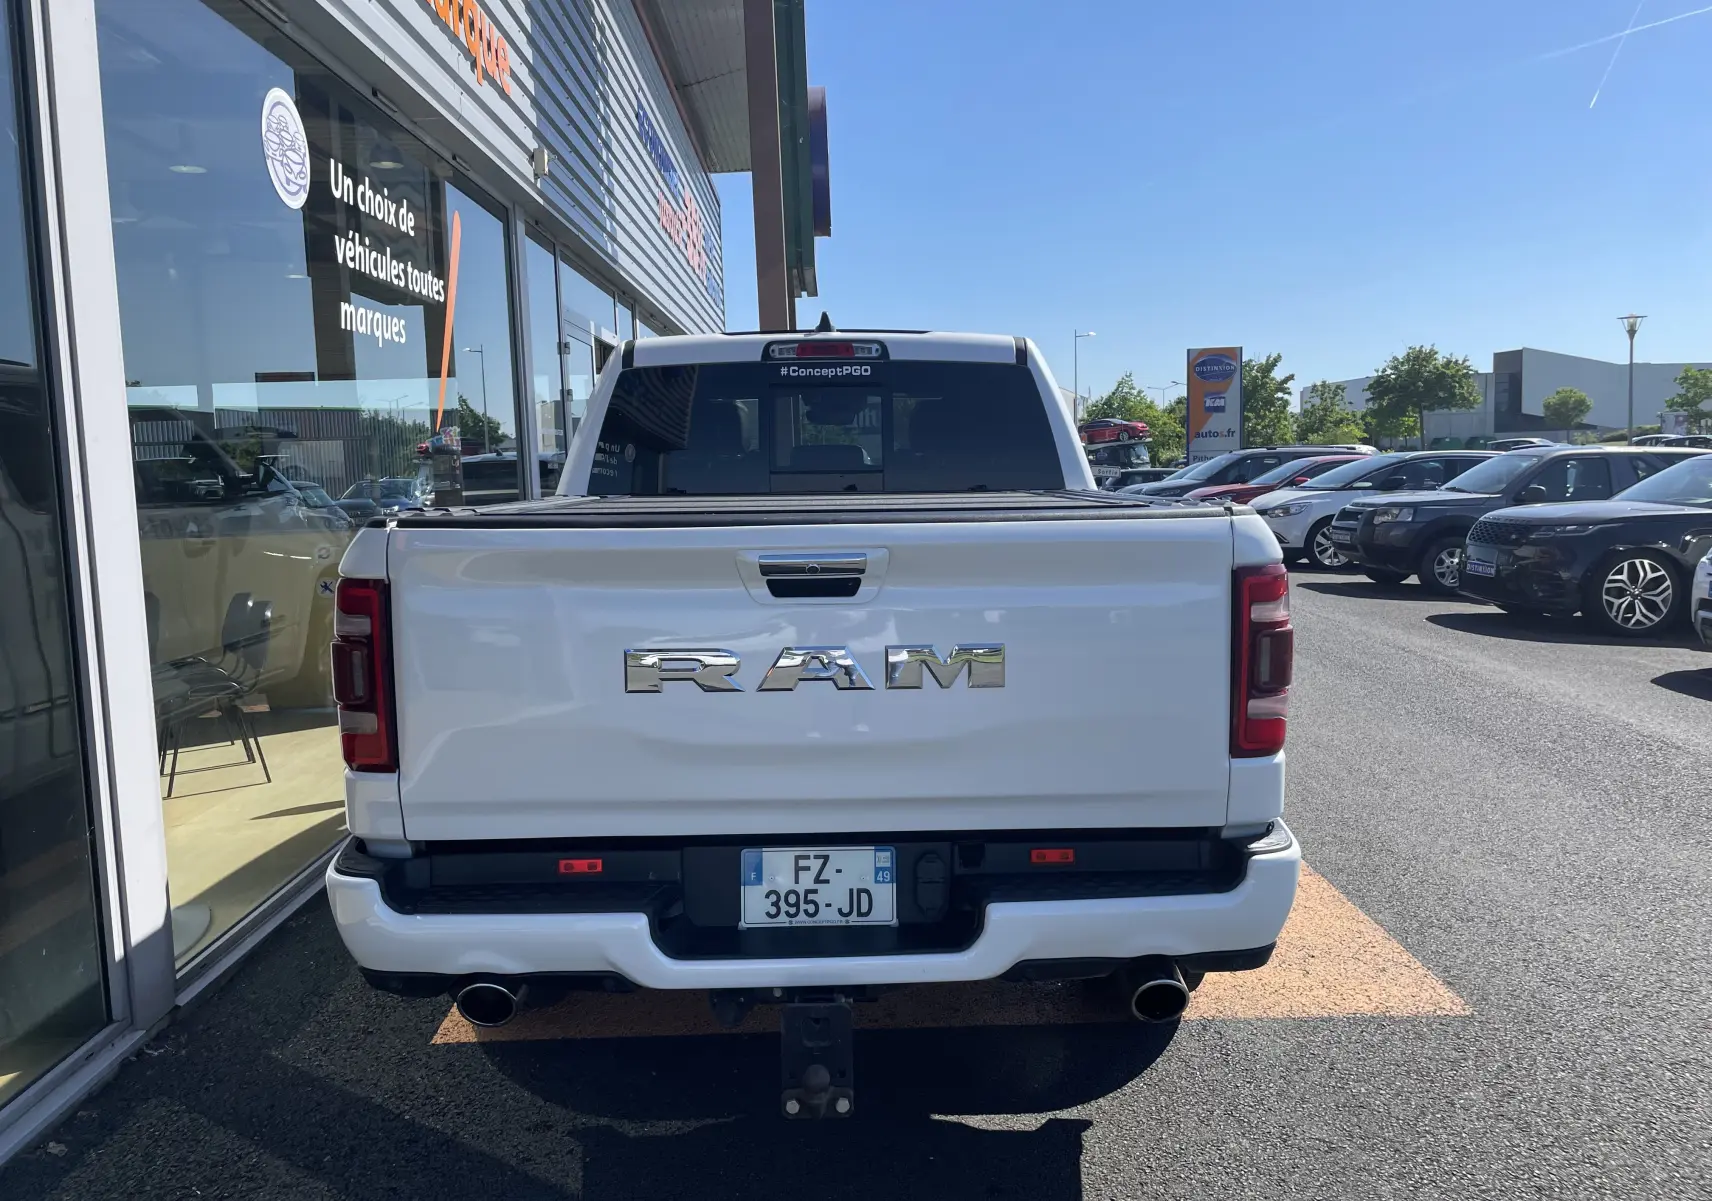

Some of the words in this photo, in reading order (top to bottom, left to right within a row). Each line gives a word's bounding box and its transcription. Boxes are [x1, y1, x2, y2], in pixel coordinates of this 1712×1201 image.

[330, 157, 354, 206] Un
[357, 176, 396, 228] choix
[398, 199, 415, 237] de
[334, 229, 405, 289] véhicules
[407, 260, 445, 303] toutes
[340, 301, 406, 348] marques
[780, 365, 871, 378] #ConceptPGO
[1194, 428, 1236, 439] autos.fr
[624, 643, 1006, 693] RAM
[751, 872, 757, 881] F
[793, 854, 843, 885] FZ-
[876, 870, 891, 883] 49
